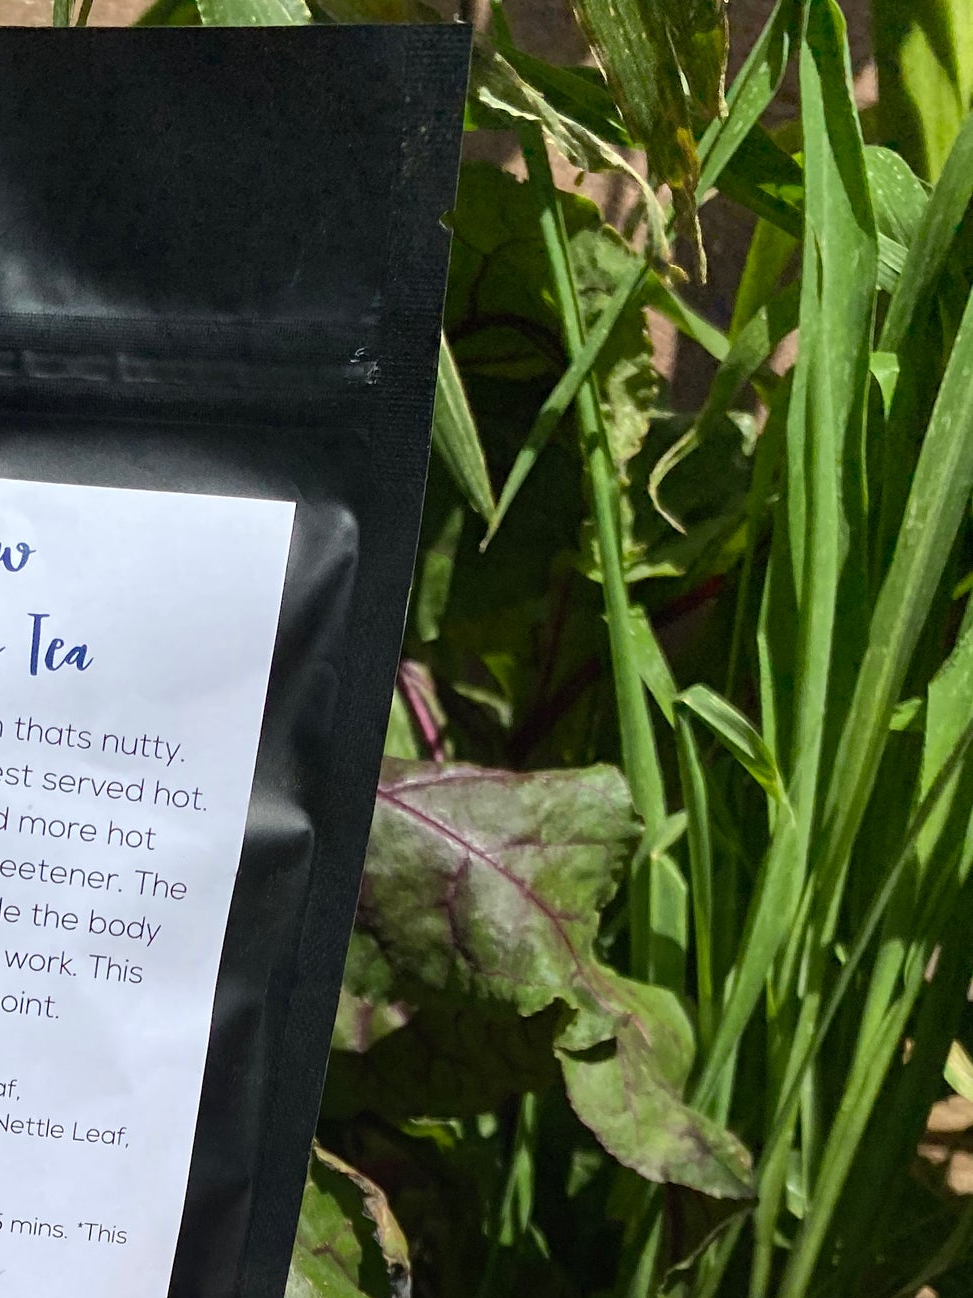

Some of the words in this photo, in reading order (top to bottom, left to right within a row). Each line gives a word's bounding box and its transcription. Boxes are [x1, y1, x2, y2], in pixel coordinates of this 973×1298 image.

[27, 612, 94, 676] Tea
[14, 716, 92, 750] thats
[101, 733, 185, 768] nutty.
[41, 772, 145, 803] served
[153, 779, 207, 812] hot.
[18, 815, 97, 843] more
[107, 819, 157, 851] hot
[134, 869, 188, 901] The
[31, 903, 79, 931] the
[88, 908, 162, 948] body
[4, 949, 77, 977] work.
[88, 953, 143, 984] This
[72, 1121, 129, 1149] Leaf,
[11, 1217, 67, 1239] mins.
